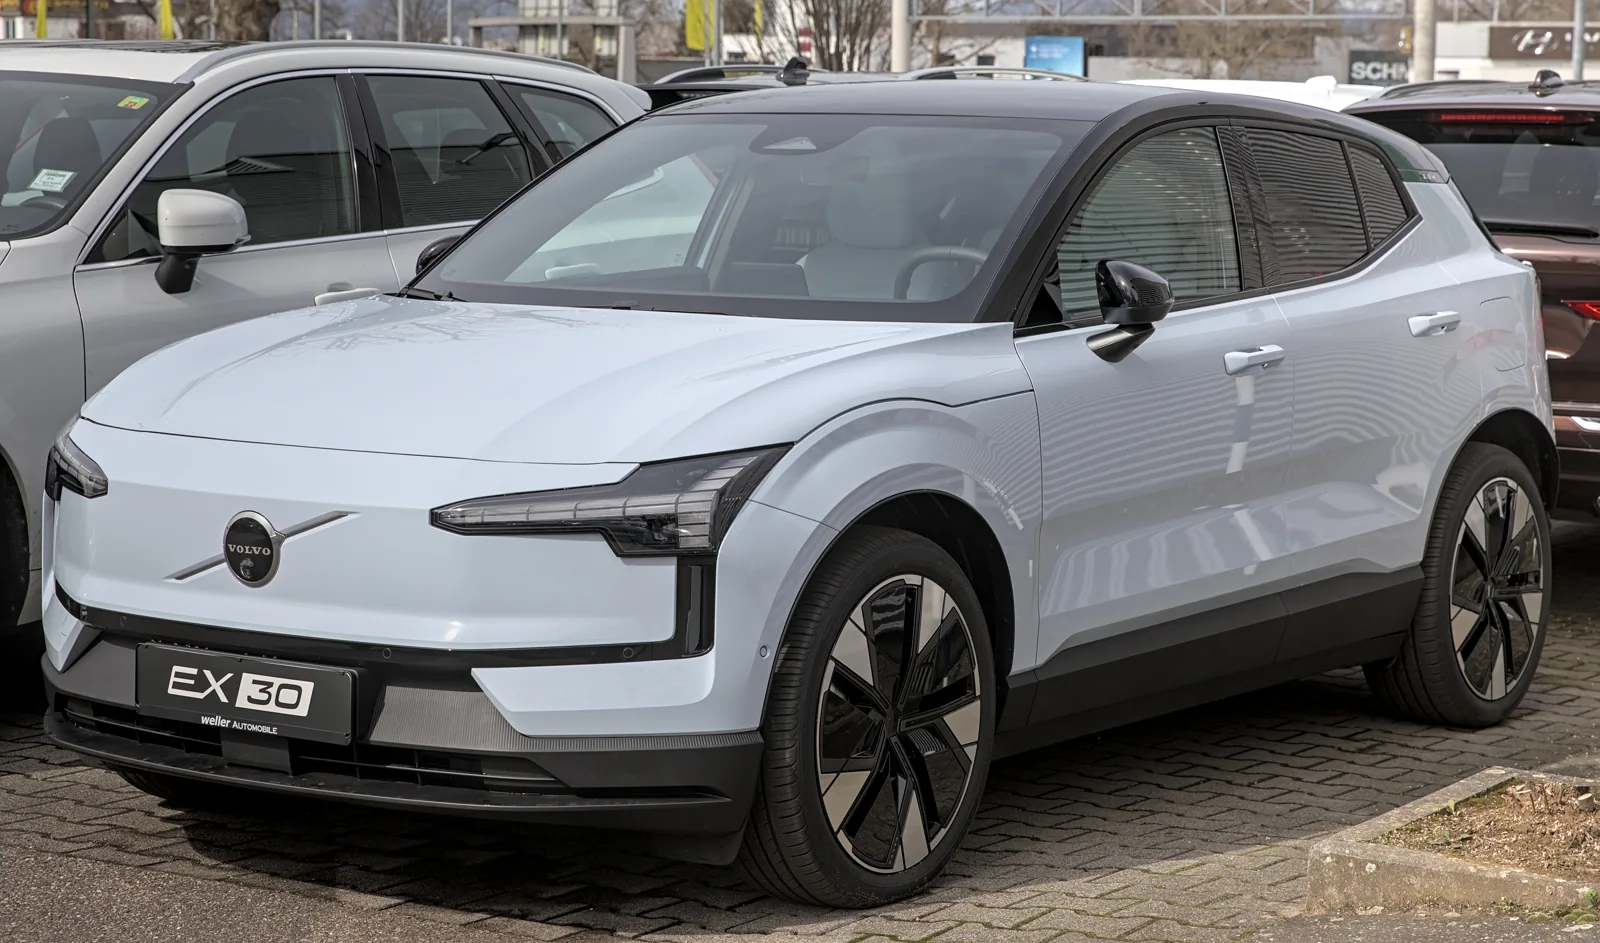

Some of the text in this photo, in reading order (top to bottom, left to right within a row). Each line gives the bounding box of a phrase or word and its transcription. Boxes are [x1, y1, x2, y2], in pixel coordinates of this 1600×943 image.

[228, 543, 271, 556] VOLVO
[167, 665, 303, 710] EX 30
[201, 715, 278, 735] weller AUTOMOBILE
